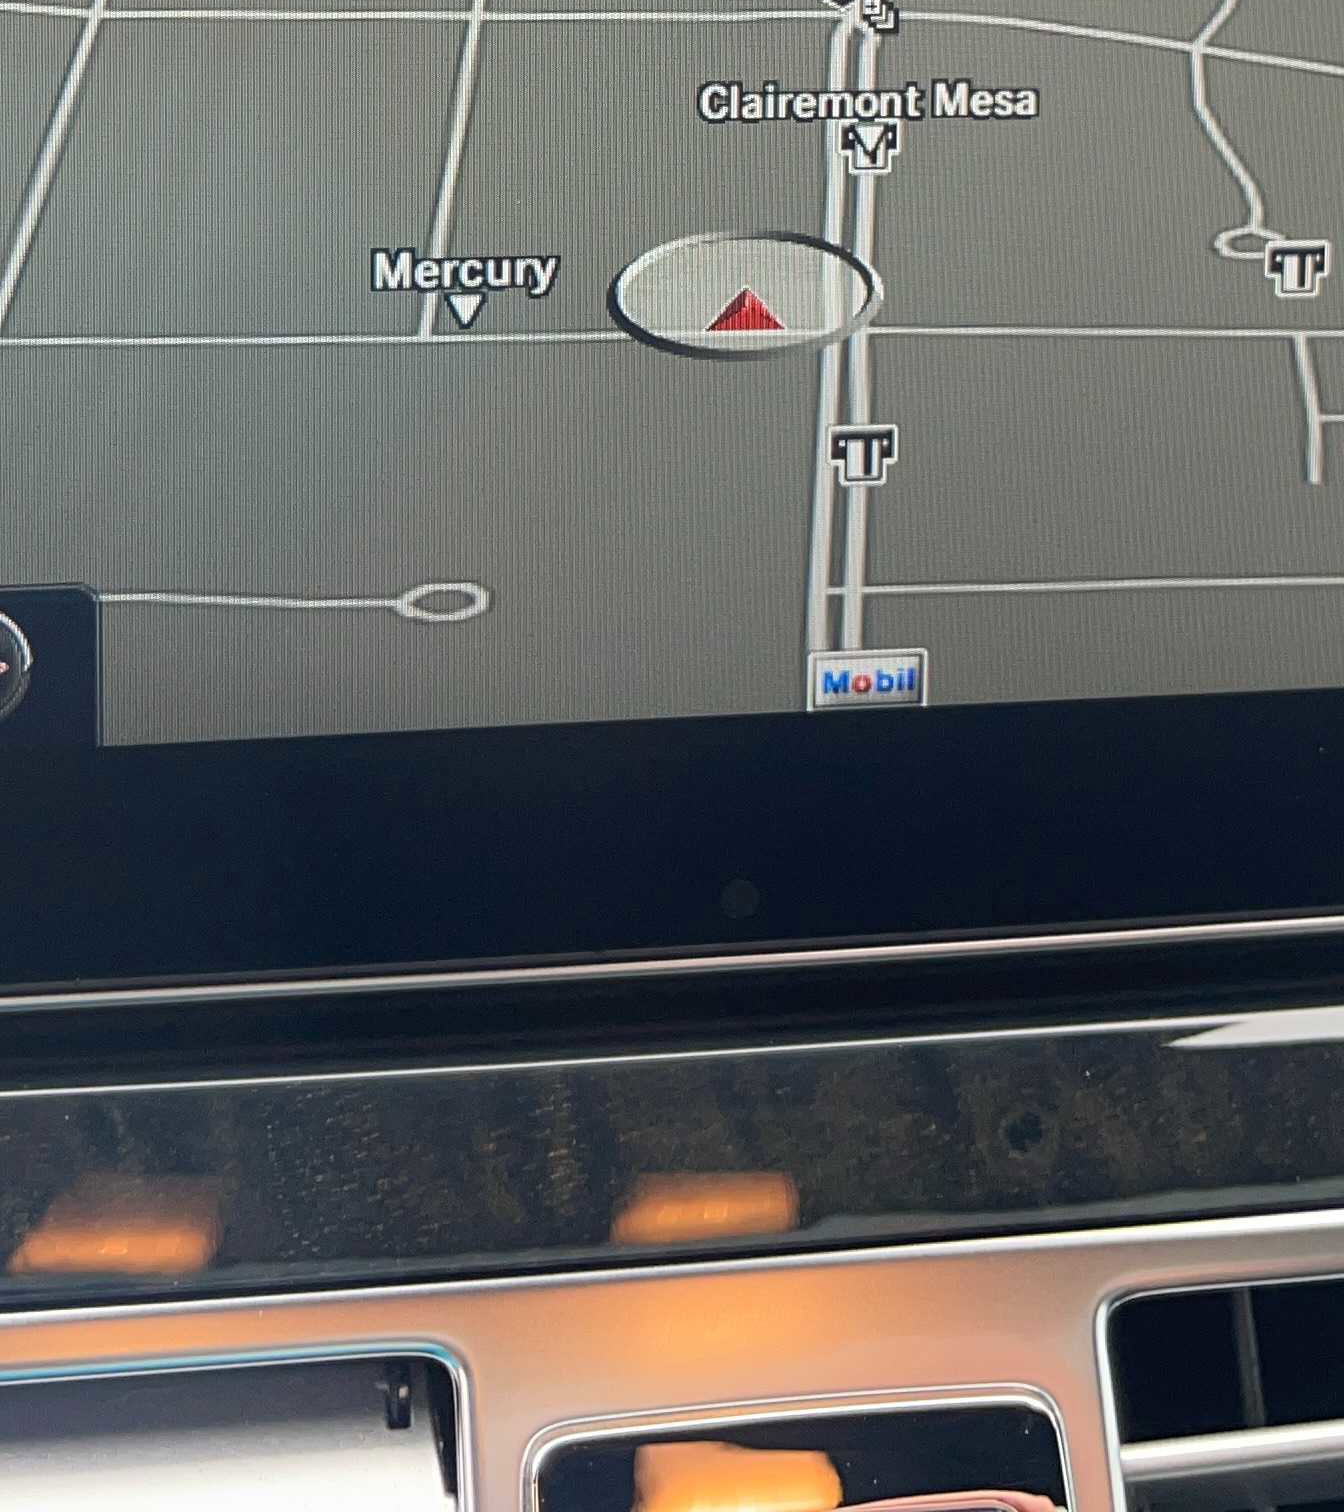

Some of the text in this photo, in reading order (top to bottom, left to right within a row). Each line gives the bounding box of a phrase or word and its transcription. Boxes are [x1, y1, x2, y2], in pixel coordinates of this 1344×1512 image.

[699, 79, 1039, 123] Clairemont Mesa
[372, 249, 558, 296] Mercury
[822, 666, 915, 695] Mobil
